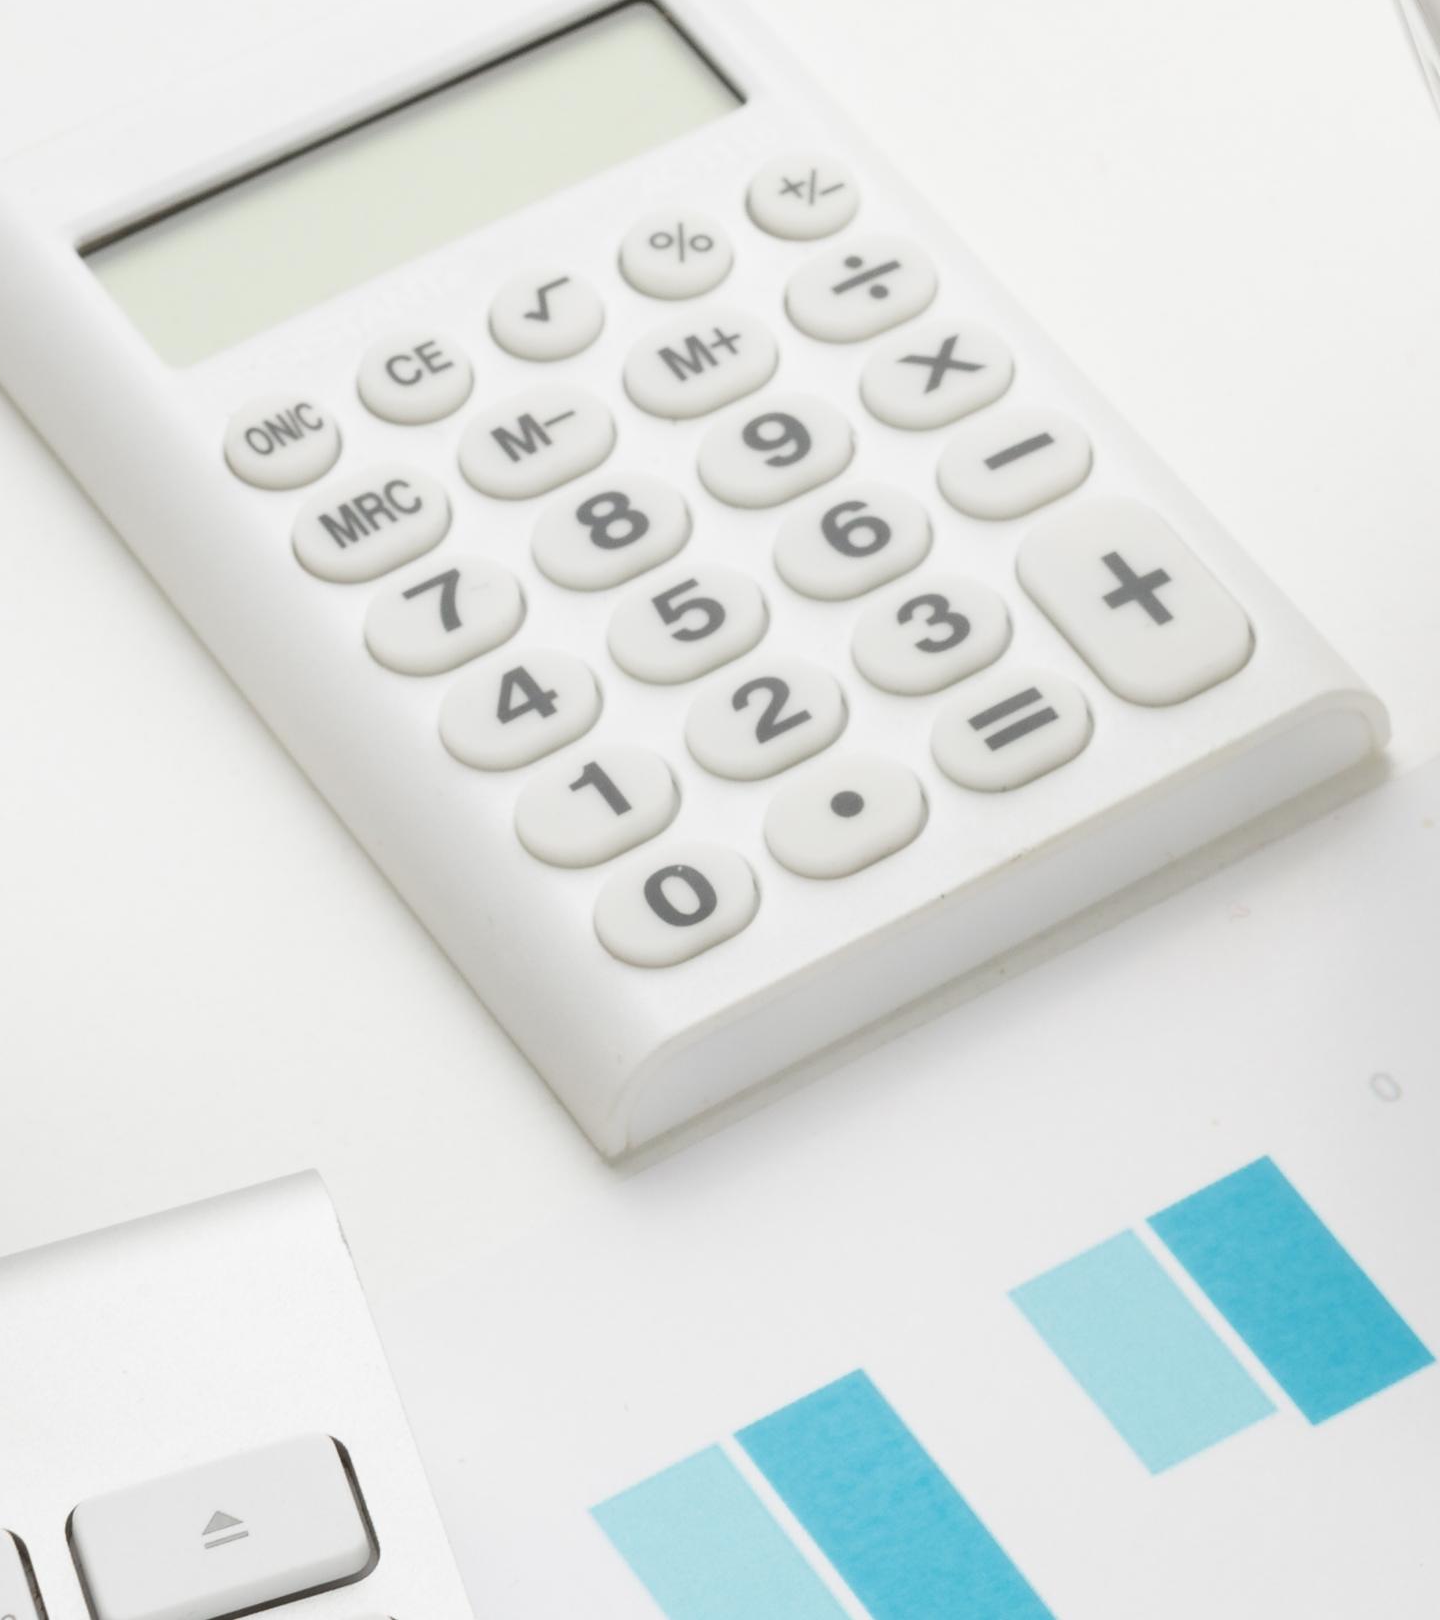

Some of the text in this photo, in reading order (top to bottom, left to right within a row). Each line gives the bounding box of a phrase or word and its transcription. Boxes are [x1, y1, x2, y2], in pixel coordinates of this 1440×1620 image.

[384, 340, 454, 388] CE
[657, 328, 740, 382] M+
[243, 402, 324, 457] ON/C
[741, 411, 813, 469] 9
[316, 478, 424, 551] MRC
[575, 490, 650, 551] 8
[820, 500, 892, 559] 6
[402, 567, 465, 633] 7
[651, 578, 727, 643] 5
[896, 593, 972, 655] 3
[496, 666, 558, 725] 4
[731, 676, 812, 745] 2
[569, 761, 632, 816] 1
[643, 864, 718, 928] 0
